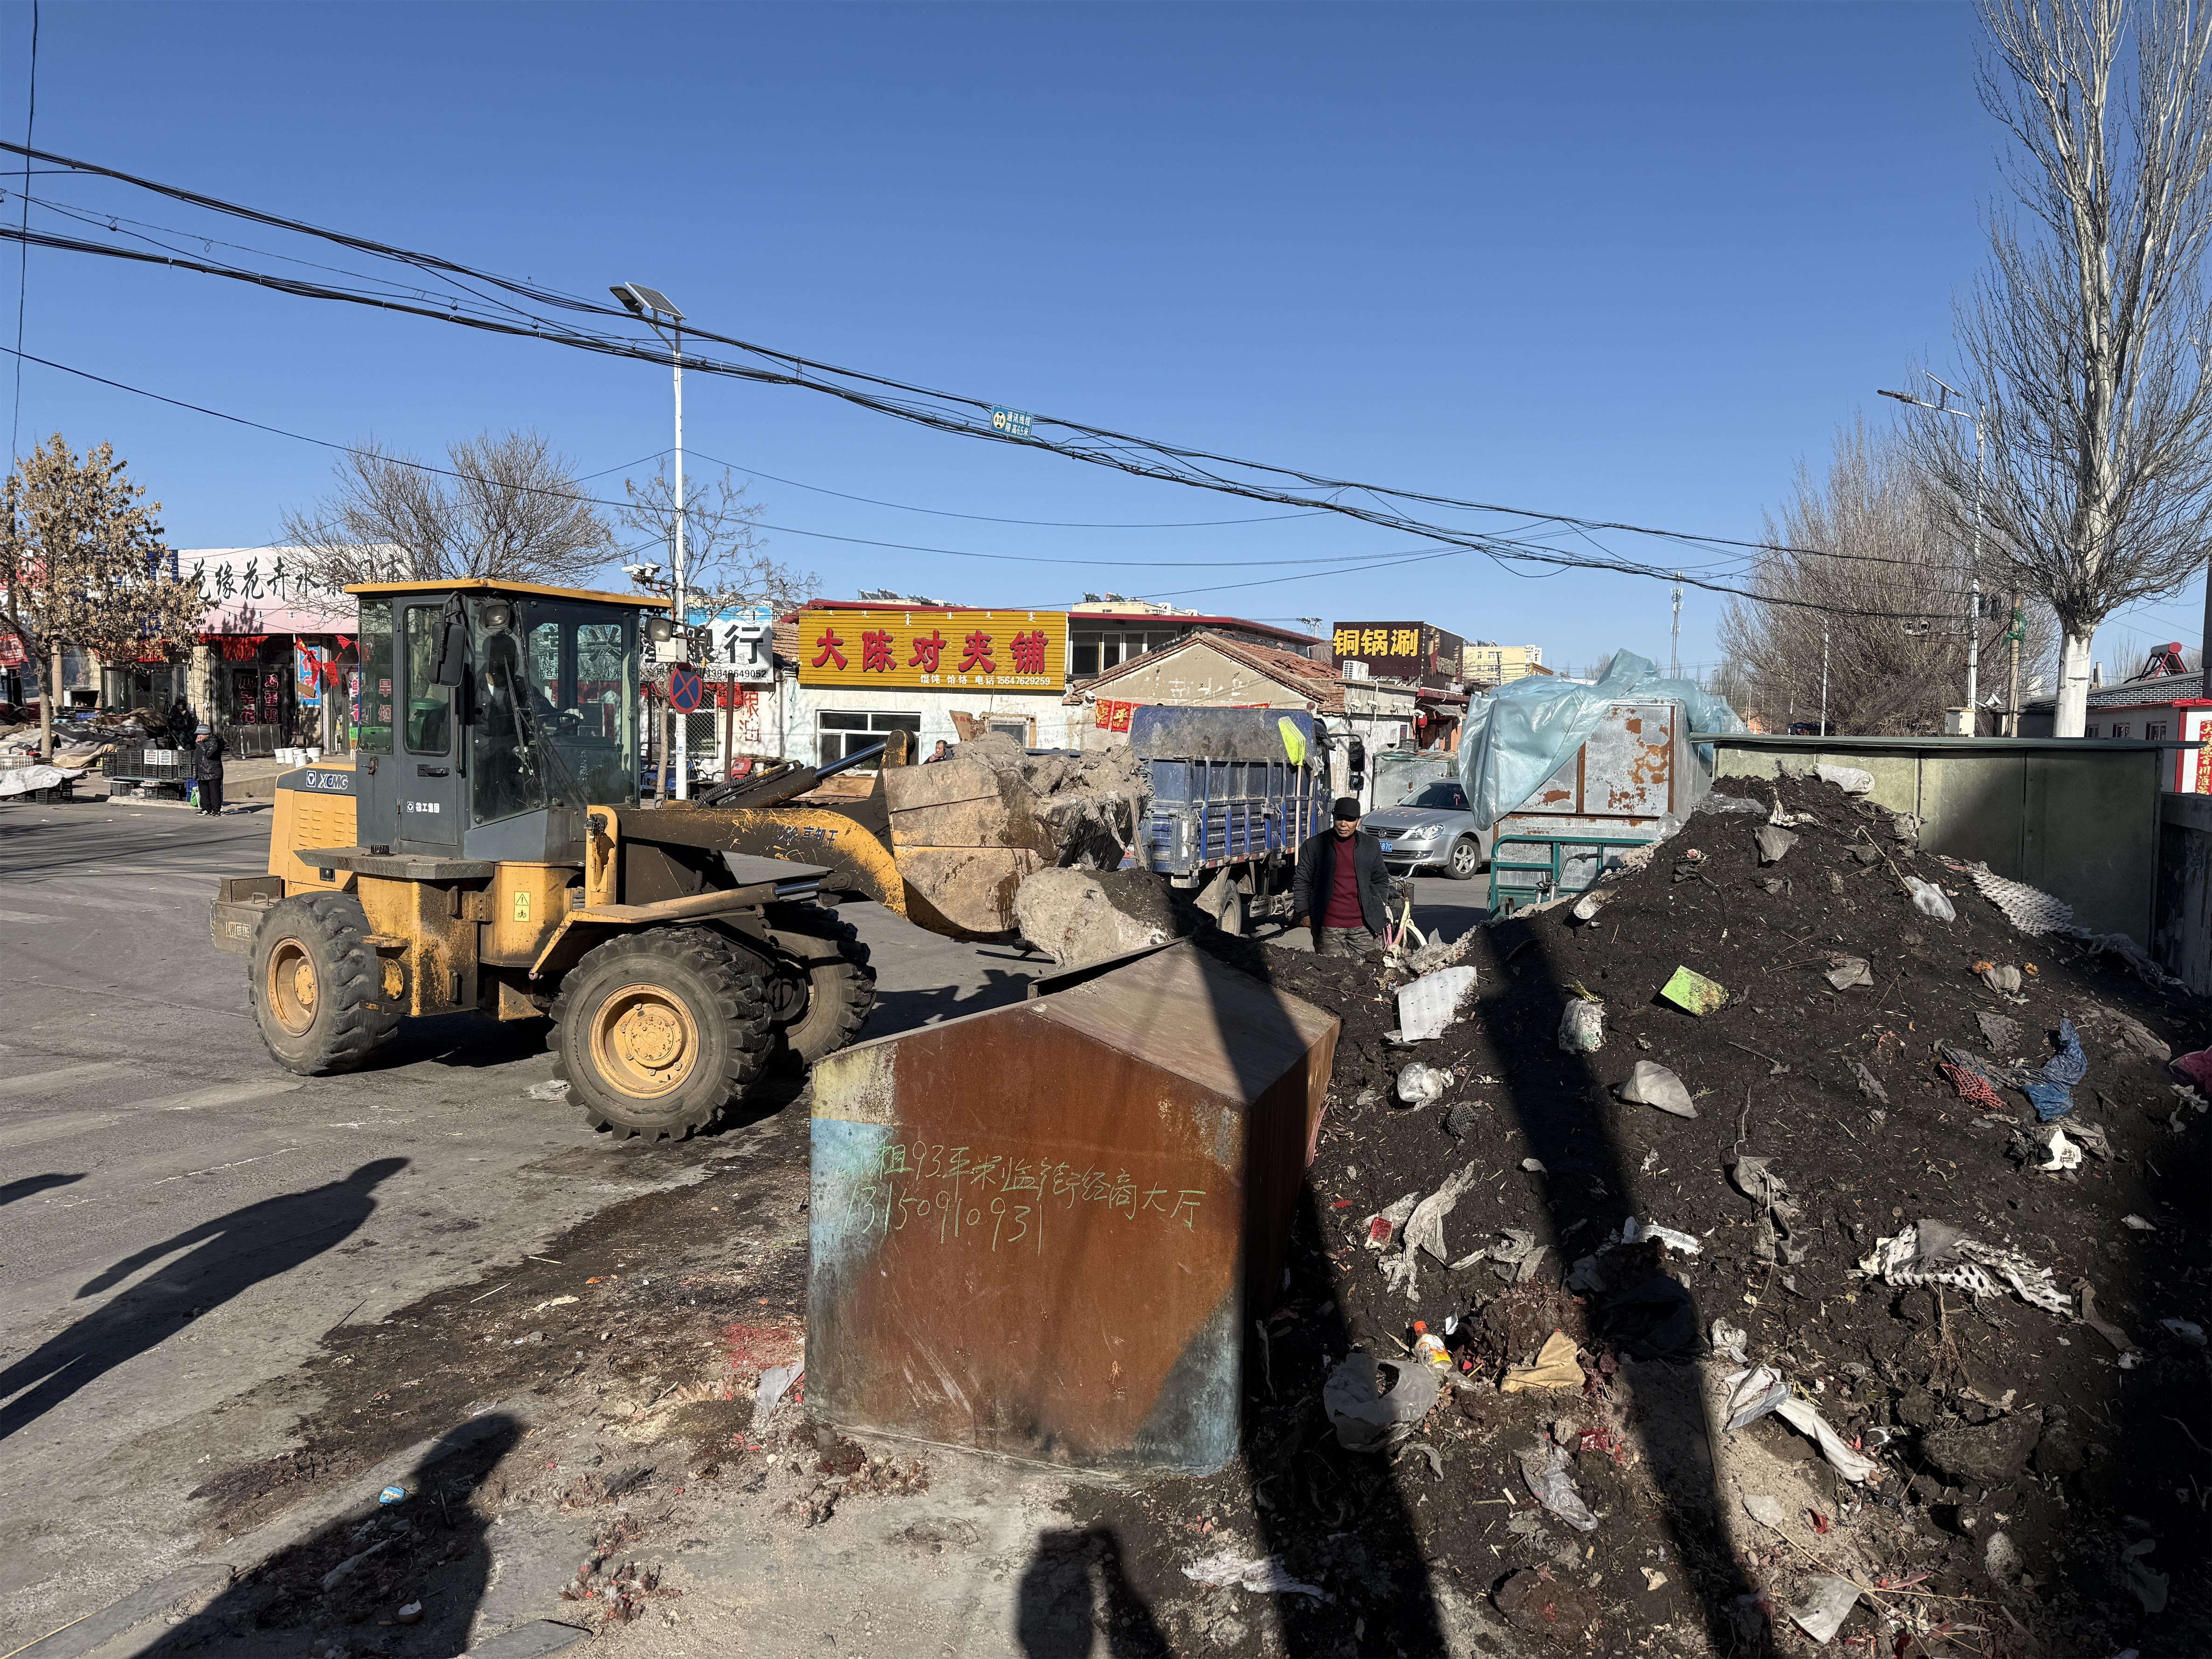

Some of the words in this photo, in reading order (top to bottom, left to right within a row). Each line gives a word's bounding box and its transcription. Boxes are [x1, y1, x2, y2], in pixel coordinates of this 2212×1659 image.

[812, 628, 1049, 674] 大陈对夹铺
[1333, 629, 1419, 657] 铜锅涮
[920, 674, 940, 684] 馄饨
[975, 675, 995, 686] 电话
[996, 676, 1050, 686] 15647629259
[317, 773, 348, 790] XCMG
[415, 802, 440, 813] 徐工集团
[843, 1181, 1042, 1257] 13150910931
